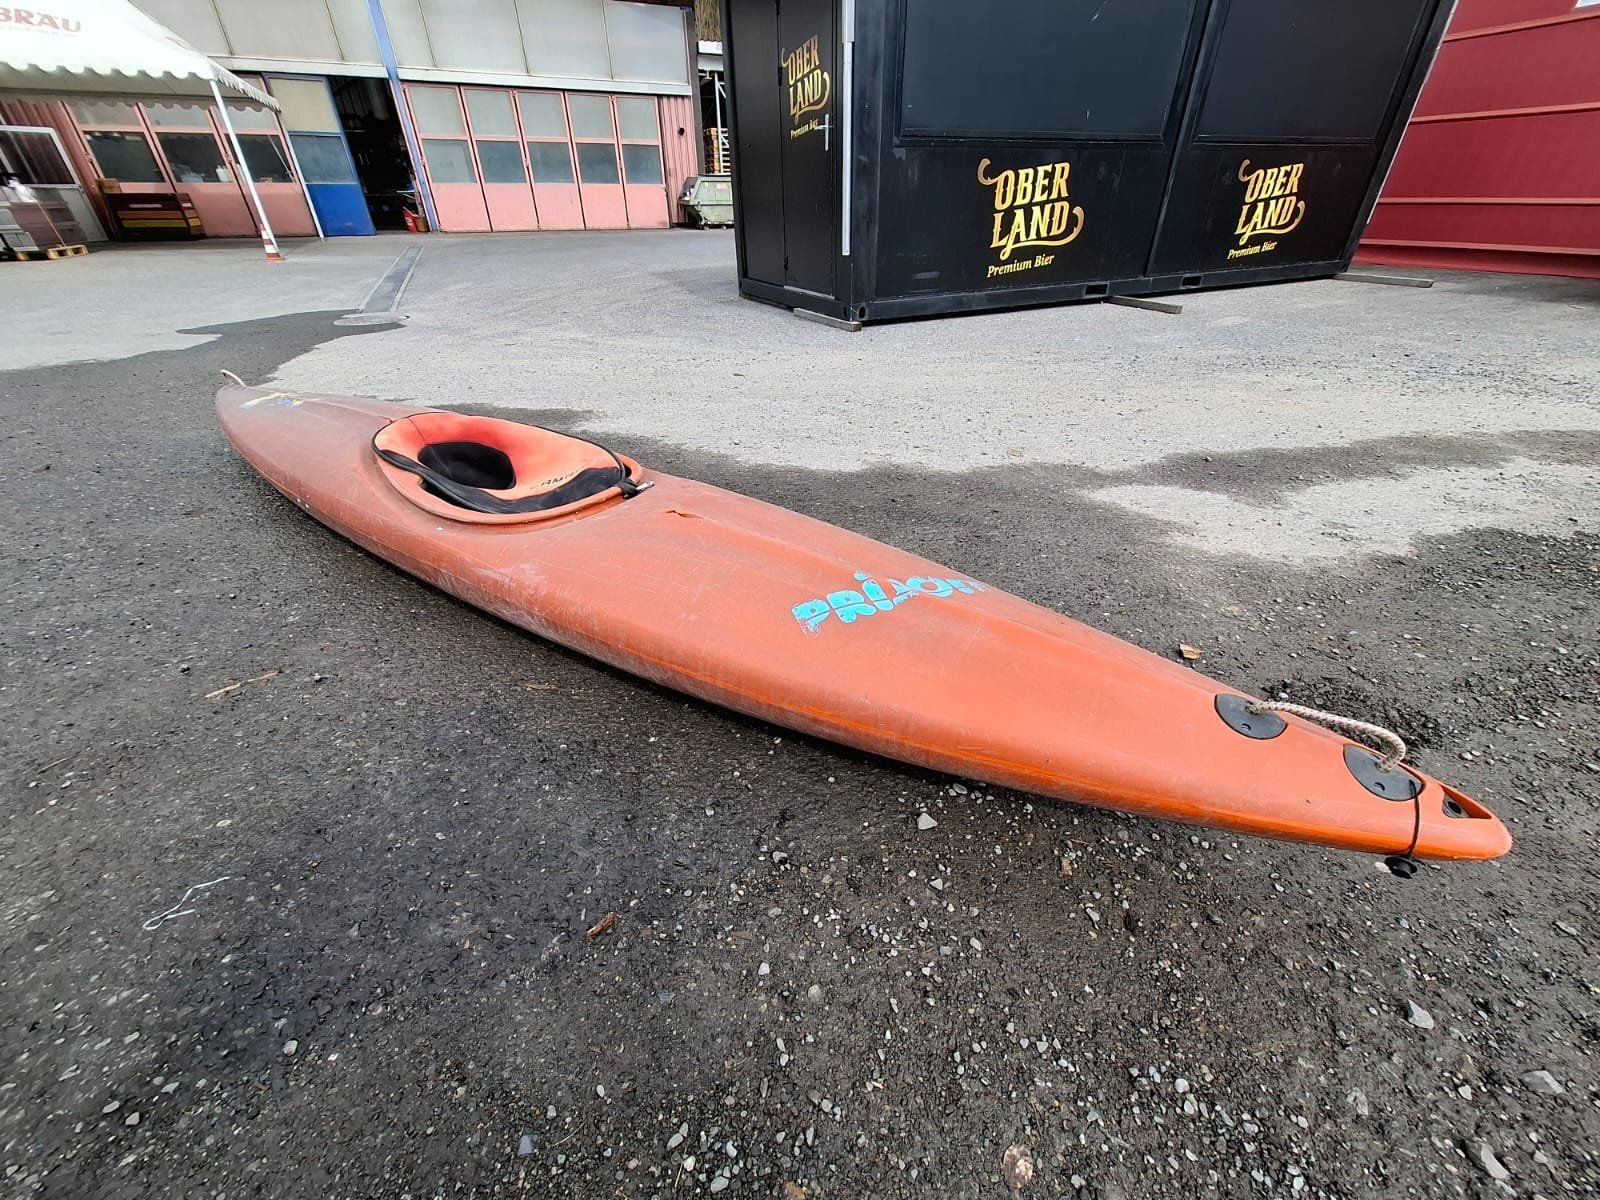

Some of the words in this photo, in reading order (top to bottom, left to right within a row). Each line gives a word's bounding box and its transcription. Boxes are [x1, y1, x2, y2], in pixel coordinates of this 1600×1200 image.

[782, 35, 819, 86] OBER
[789, 68, 830, 125] LAND
[976, 158, 1070, 211] OBER
[1238, 159, 1304, 203] OBER
[990, 201, 1085, 261] LAND
[1234, 196, 1305, 246] LAND
[986, 259, 1032, 278] Premium
[1033, 253, 1055, 268] Bier
[1227, 245, 1261, 260] Premium
[1261, 241, 1278, 252] Bier
